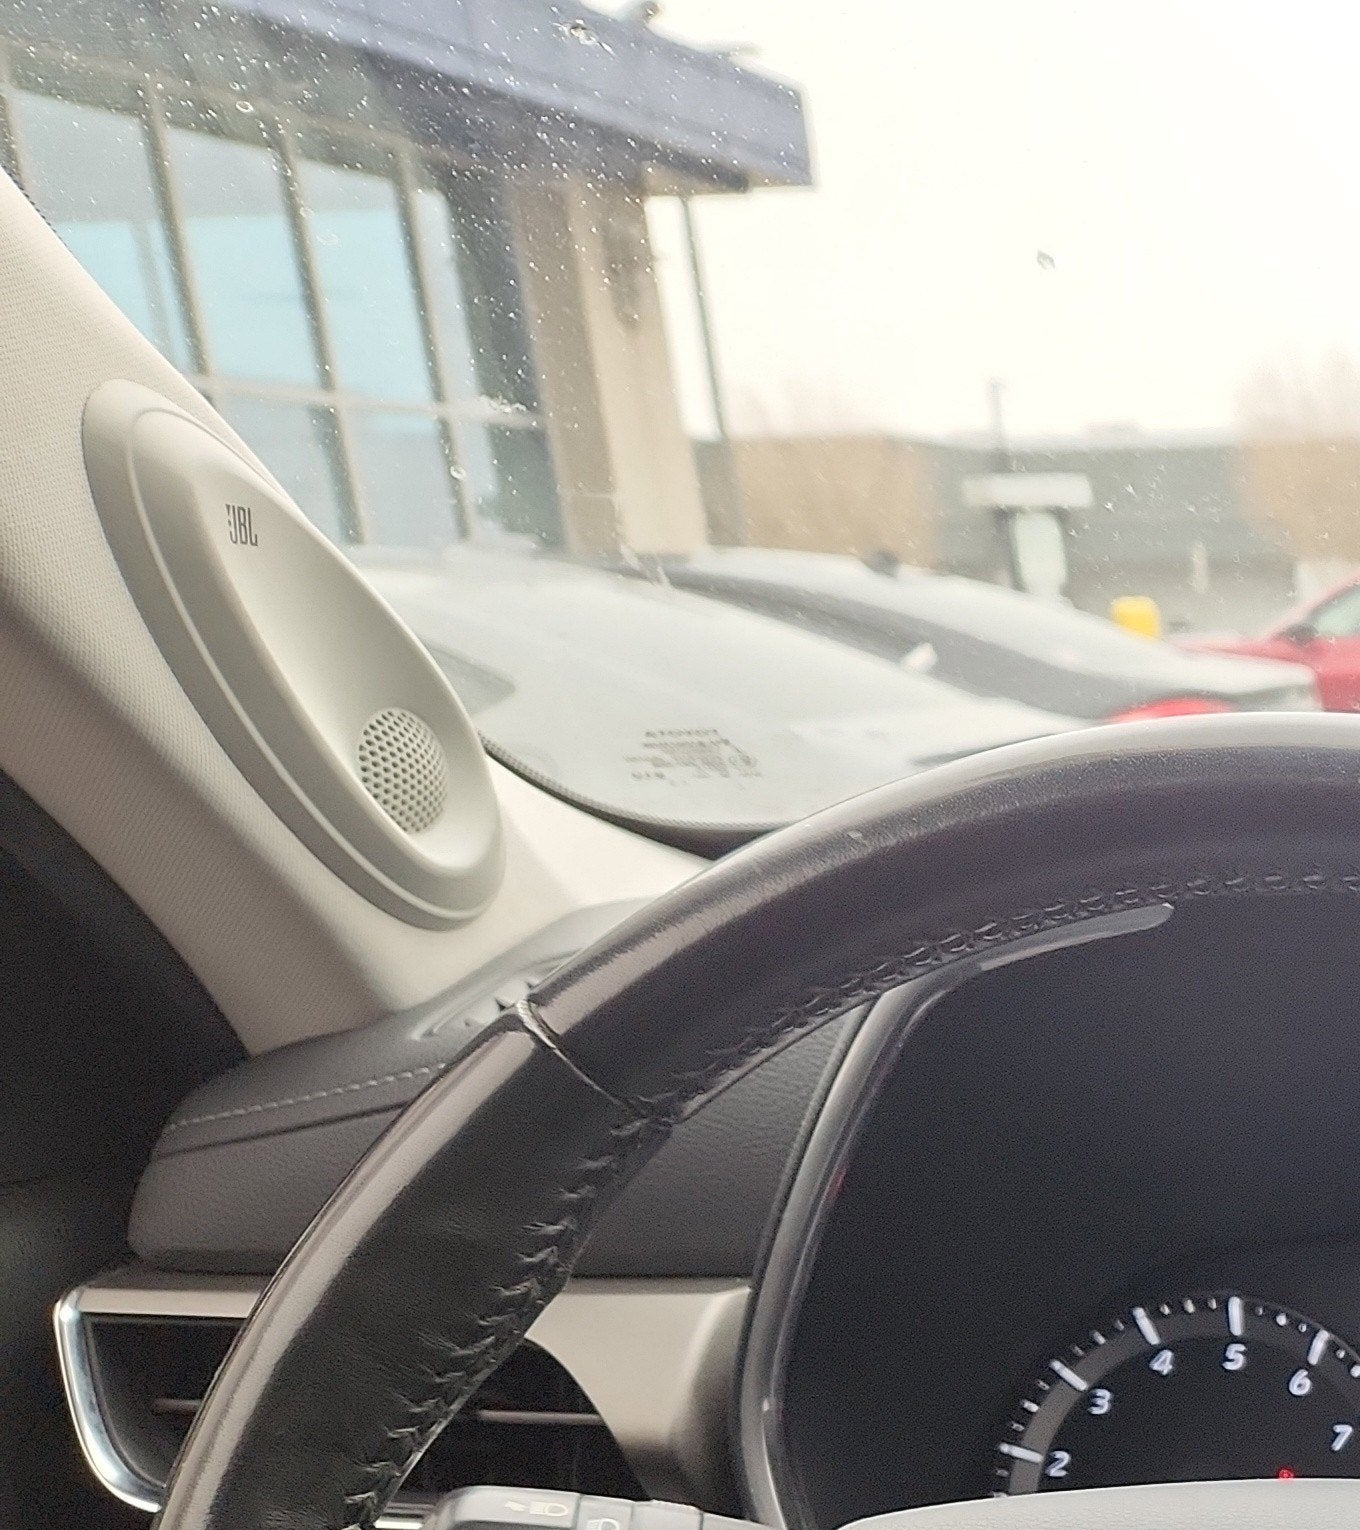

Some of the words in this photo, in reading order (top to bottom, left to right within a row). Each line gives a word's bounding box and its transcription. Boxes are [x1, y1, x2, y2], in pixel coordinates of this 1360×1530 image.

[226, 504, 258, 547] JBL
[1149, 1348, 1175, 1376] 4
[1222, 1342, 1248, 1371] 5
[1288, 1368, 1312, 1397] 6
[1088, 1387, 1113, 1416] 3
[1331, 1423, 1354, 1452] 7
[1047, 1449, 1072, 1478] 2
